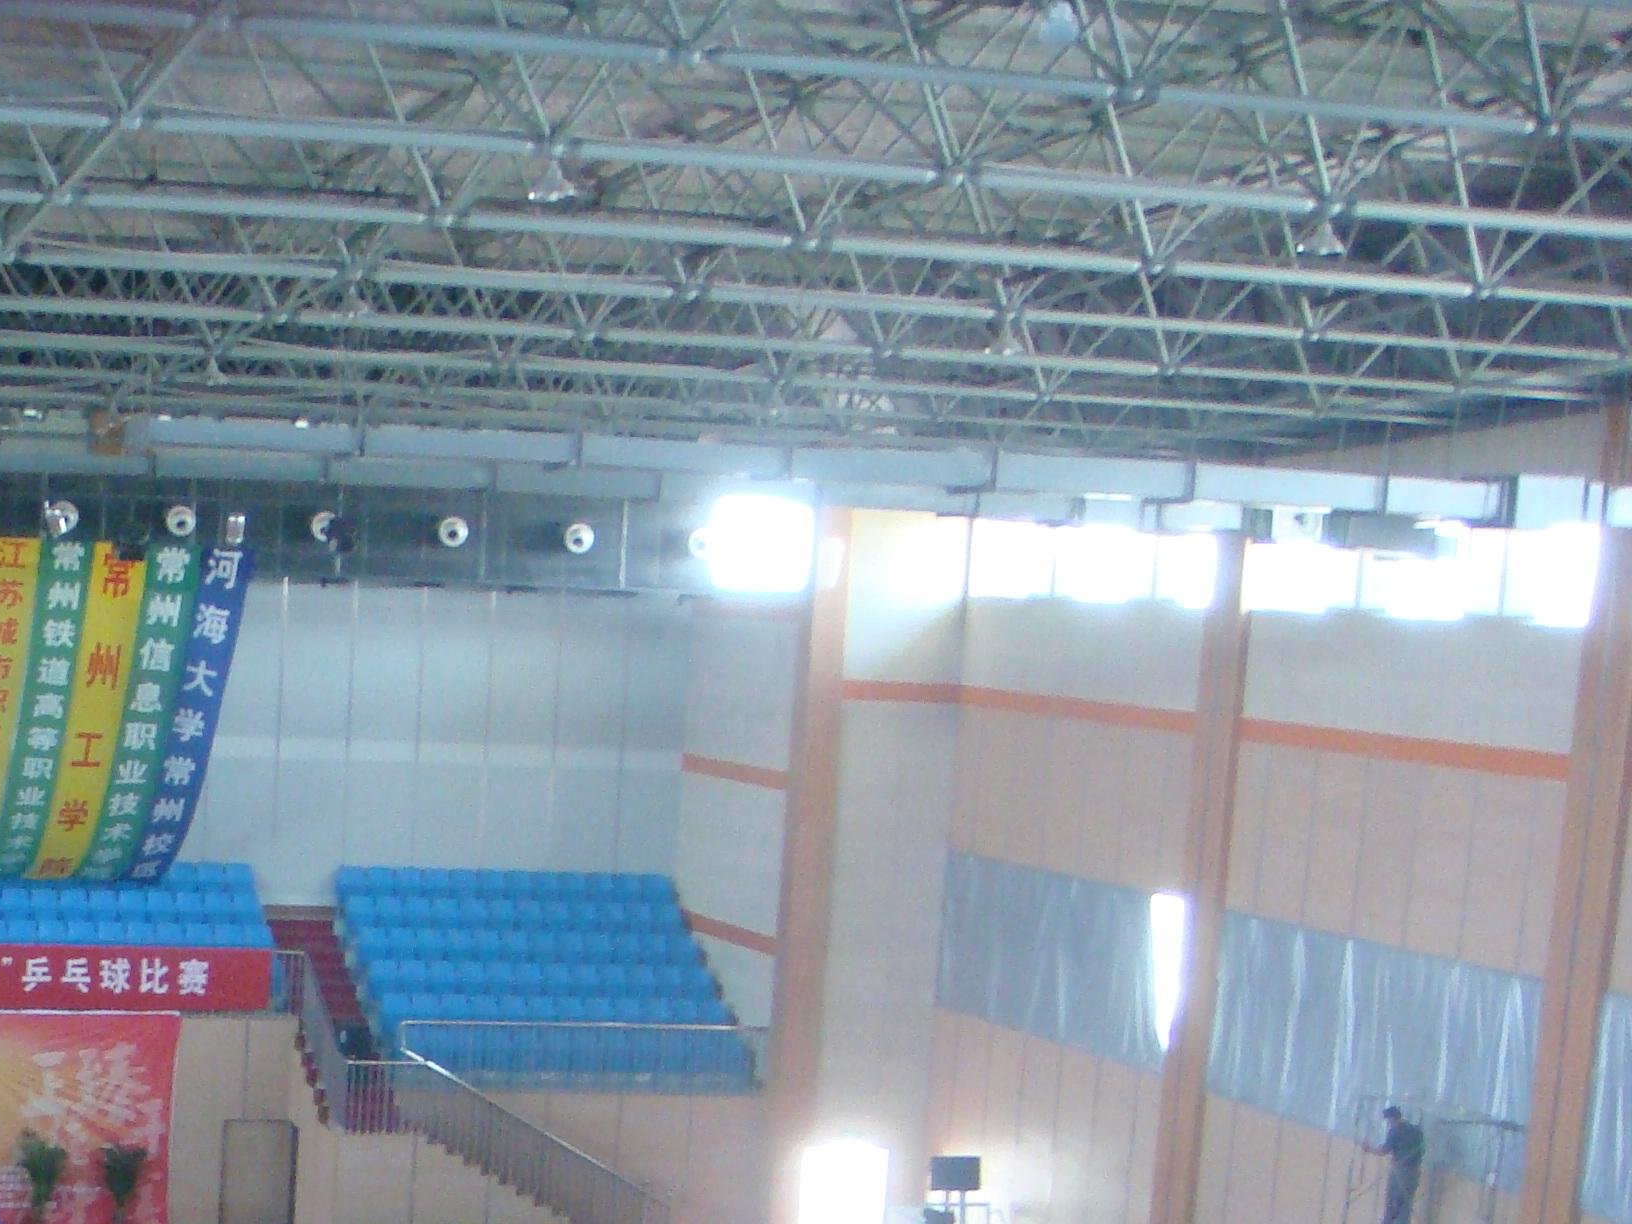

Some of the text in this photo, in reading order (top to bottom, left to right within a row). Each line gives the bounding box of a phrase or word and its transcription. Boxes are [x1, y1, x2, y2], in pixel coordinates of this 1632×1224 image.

[82, 547, 192, 879] 常州信息职业技术学
